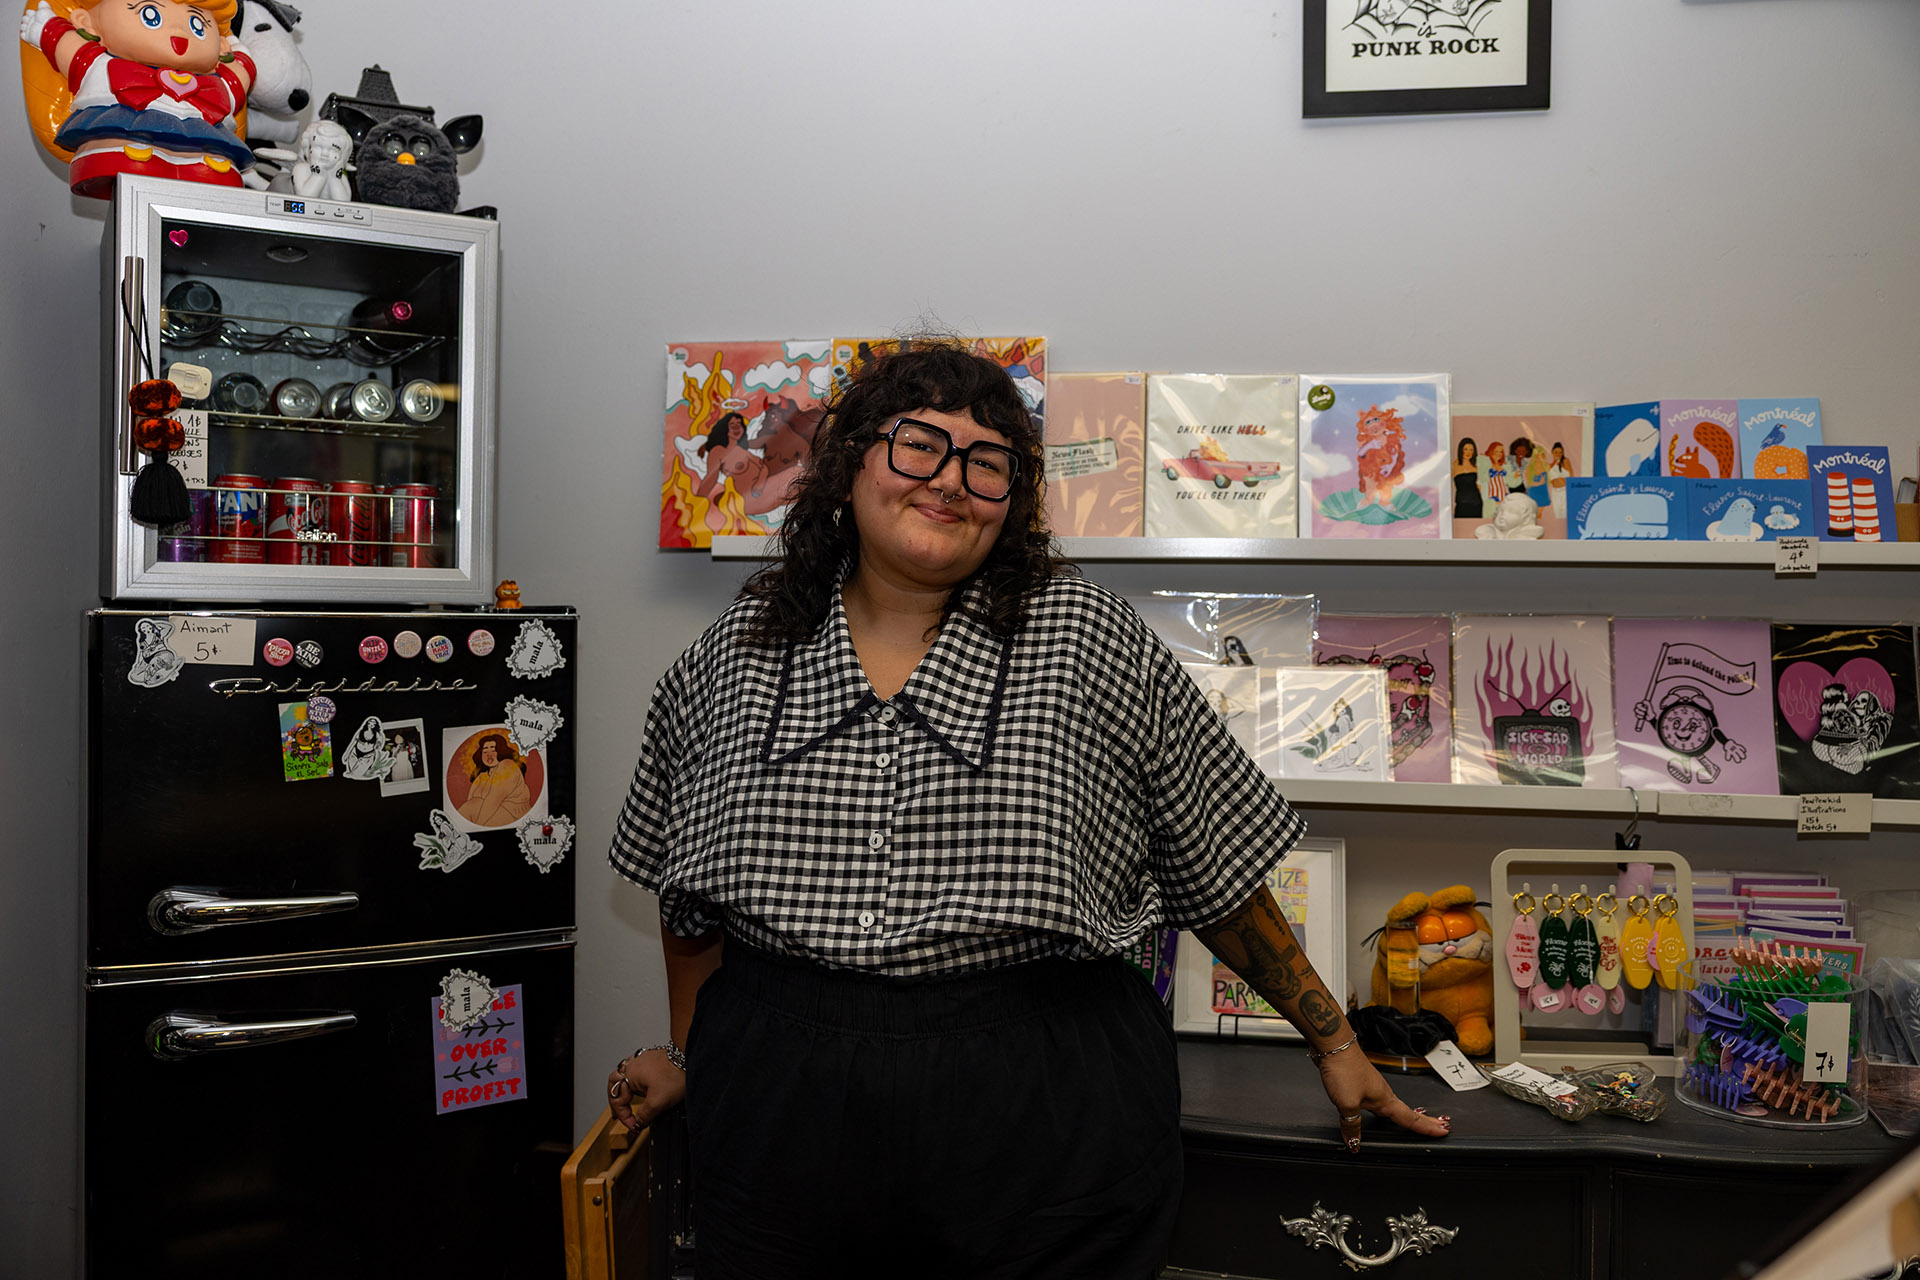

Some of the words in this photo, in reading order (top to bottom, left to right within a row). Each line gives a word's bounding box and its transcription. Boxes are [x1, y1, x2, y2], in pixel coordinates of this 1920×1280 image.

[1417, 21, 1437, 38] is
[1352, 40, 1422, 58] PUNK
[1429, 37, 1500, 56] ROCK
[1667, 405, 1737, 429] Montréal
[1743, 406, 1817, 431] Montréal
[1177, 425, 1207, 434] DRIVE
[1211, 425, 1234, 434] LIKE
[1236, 424, 1267, 436] HELL
[1813, 451, 1886, 474] Montréal
[1211, 491, 1229, 500] GET
[180, 619, 232, 634] Aimant
[295, 647, 321, 666] KIND
[305, 643, 320, 656] BE
[529, 640, 544, 665] mala
[209, 676, 478, 700] Frigidaire
[314, 705, 330, 713] GET
[520, 718, 544, 731] mala
[1508, 732, 1538, 743] SICK
[1542, 731, 1569, 744] SAD
[1517, 753, 1563, 765] WORLD
[1801, 823, 1824, 831] Patch
[533, 836, 557, 845] mala
[1265, 870, 1304, 889] SIZE
[461, 986, 471, 1013] mala
[1213, 979, 1260, 1007] PARA
[450, 1037, 507, 1062] OVER
[442, 1077, 522, 1109] PROFIT
